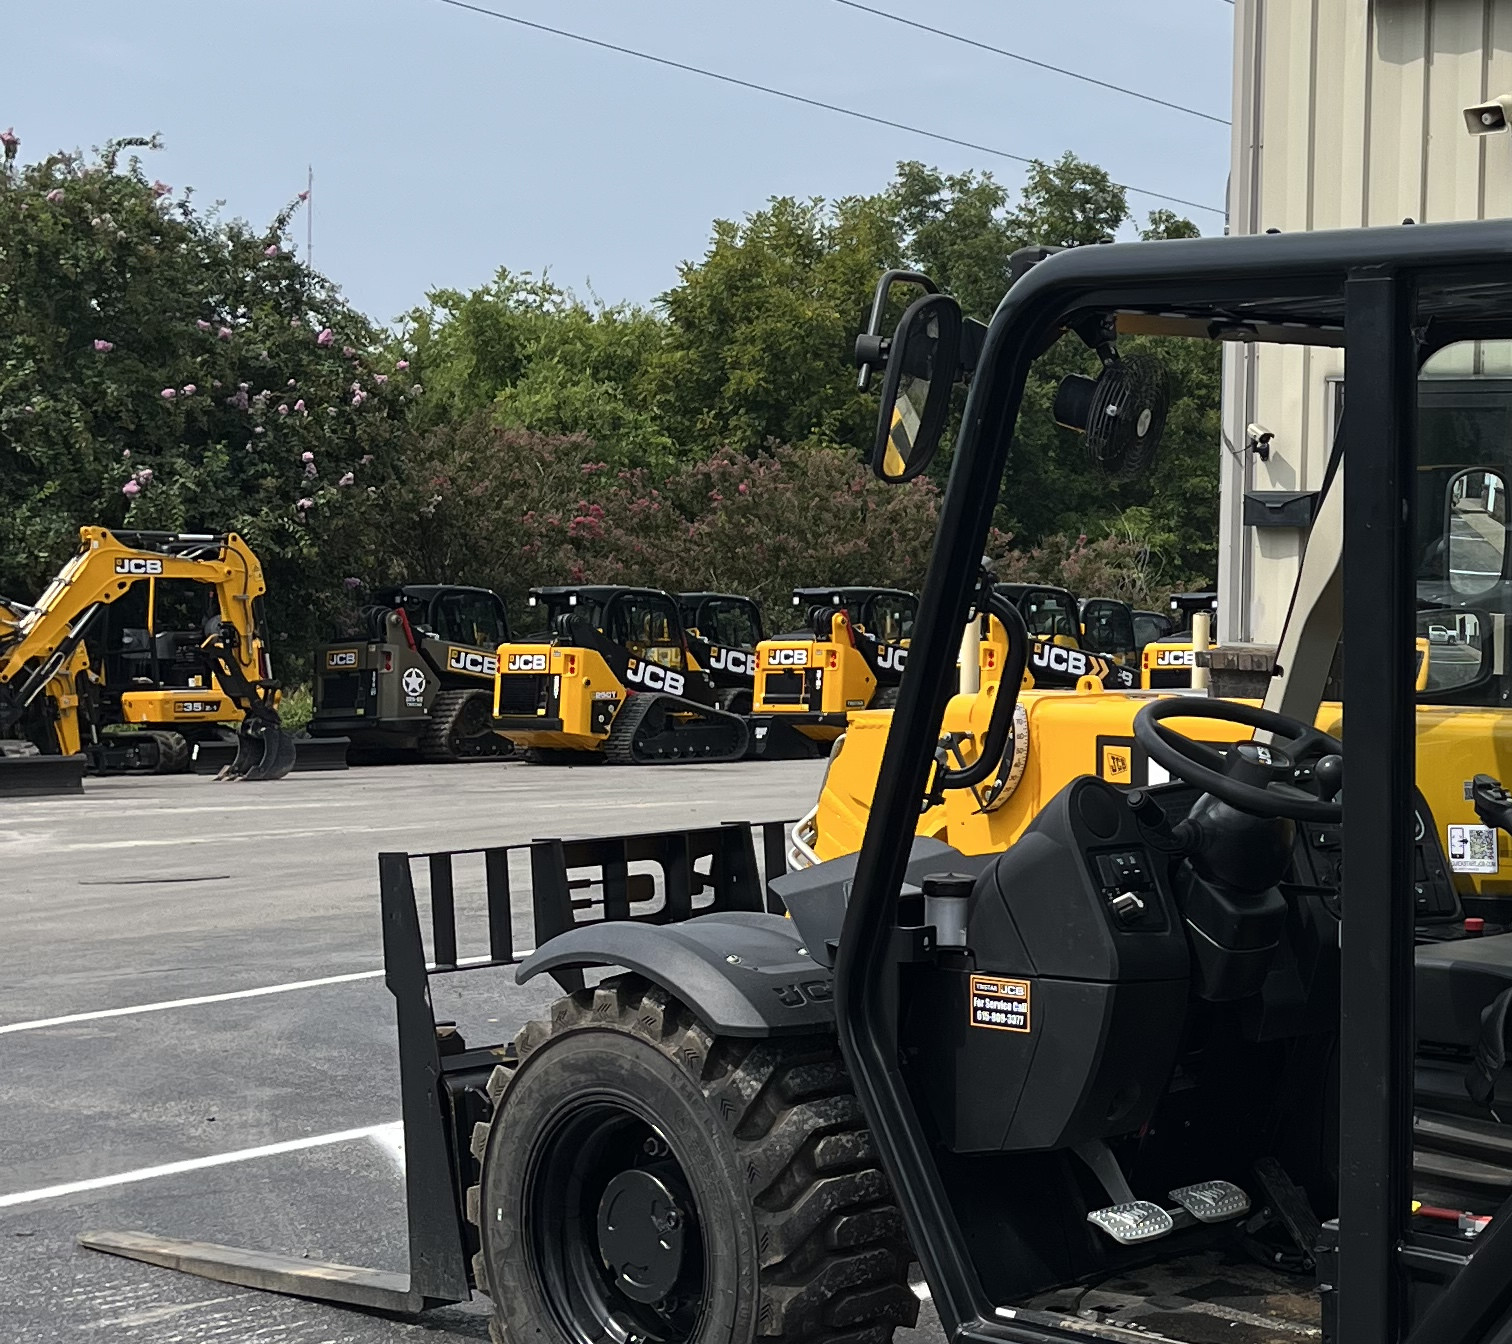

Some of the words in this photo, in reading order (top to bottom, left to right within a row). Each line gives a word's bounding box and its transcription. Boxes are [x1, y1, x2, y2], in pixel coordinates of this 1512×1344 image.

[116, 559, 162, 574] JCB
[329, 653, 356, 665] JCB
[451, 652, 498, 674] JCB
[508, 655, 546, 670] JCB
[768, 649, 808, 665] JCB
[1033, 643, 1086, 675] JCB
[1157, 650, 1195, 665] JCB
[626, 661, 685, 696] JCB
[1109, 755, 1128, 774] JCB
[1001, 985, 1025, 995] JCB
[973, 996, 985, 1007] For
[985, 998, 1012, 1011] Service
[1012, 1001, 1028, 1012] Call
